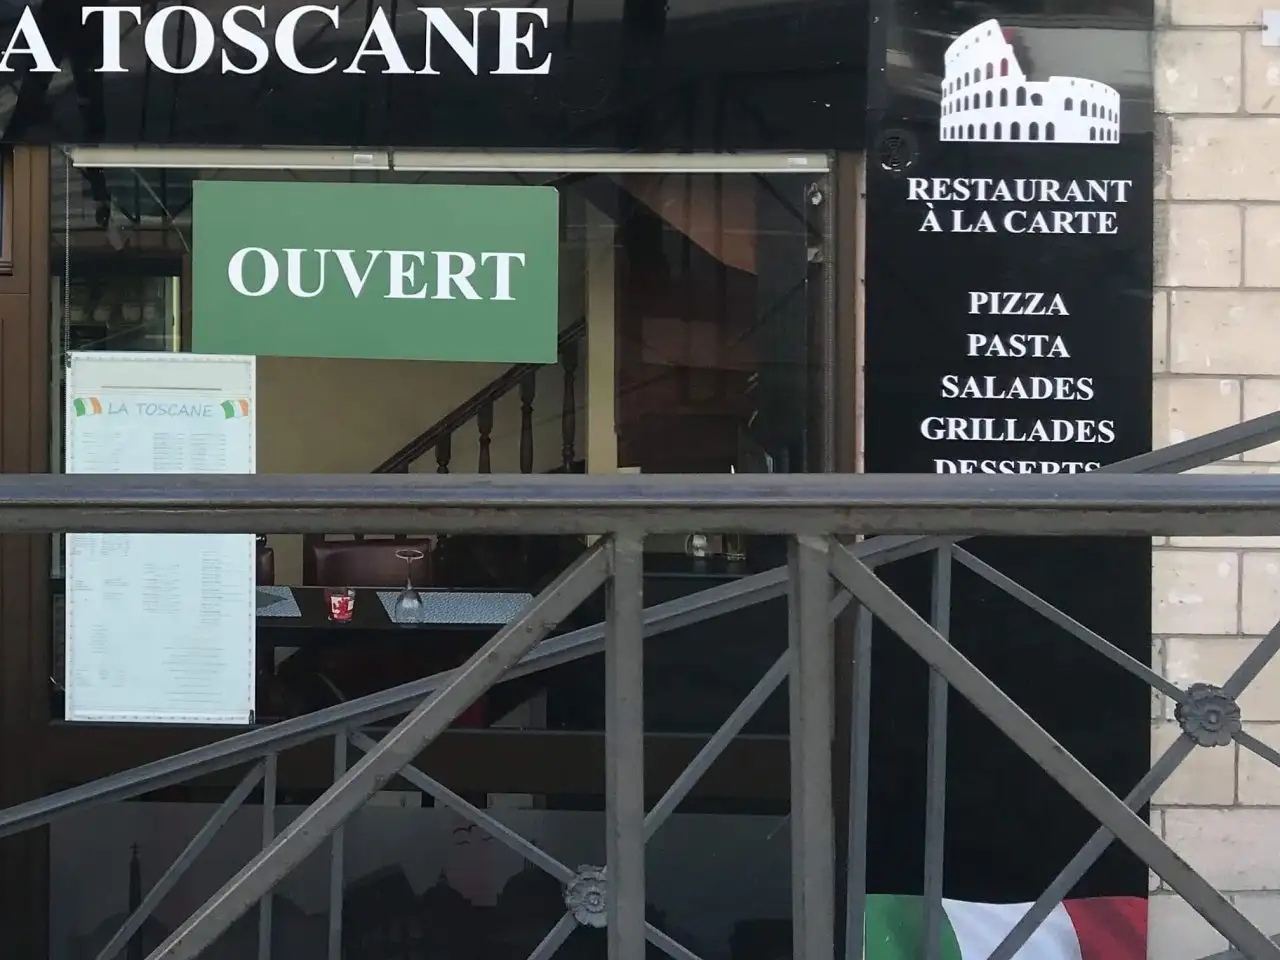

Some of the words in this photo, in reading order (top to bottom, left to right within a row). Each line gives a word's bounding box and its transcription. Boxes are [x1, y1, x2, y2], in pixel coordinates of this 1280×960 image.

[80, 4, 553, 76] TOSCANE
[906, 176, 1133, 204] RESTAURANT
[918, 202, 945, 233] À
[949, 208, 997, 234] LA
[1003, 209, 1119, 236] CARTE
[227, 246, 526, 302] OUVERT
[967, 290, 1070, 316] PIZZA
[966, 333, 1071, 359] PASTA
[941, 374, 1095, 401] SALADES
[107, 402, 129, 416] LA
[136, 402, 214, 418] TOSCANE
[920, 416, 1116, 444] GRILLADES
